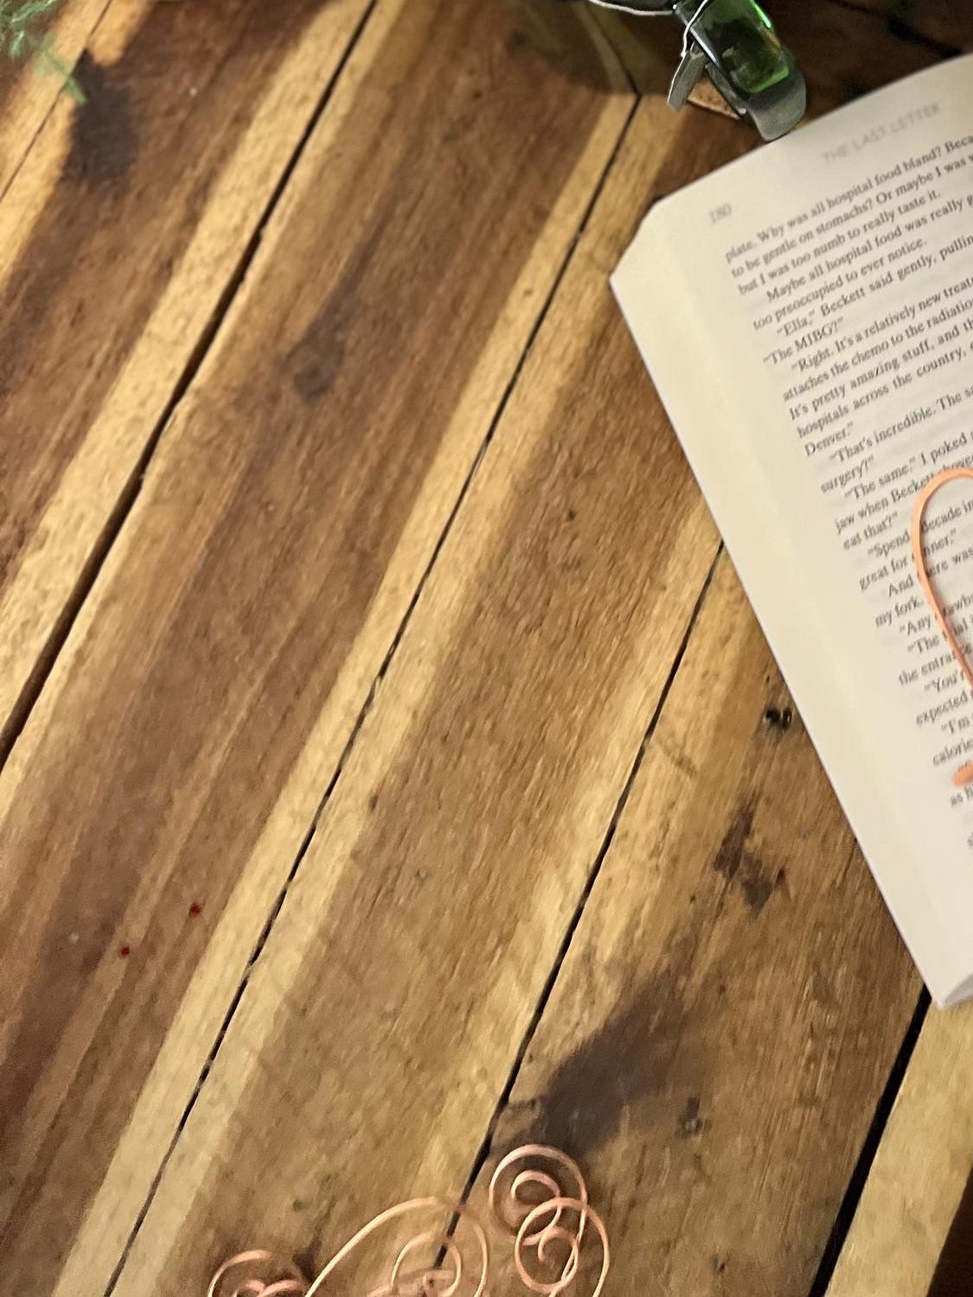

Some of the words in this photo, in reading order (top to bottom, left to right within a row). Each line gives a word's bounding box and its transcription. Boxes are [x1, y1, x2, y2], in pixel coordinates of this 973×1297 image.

[756, 224, 785, 243] Why
[786, 212, 809, 229] was
[810, 200, 826, 218] all
[825, 177, 874, 210] hospital
[874, 163, 903, 187] food
[819, 286, 867, 318] Beckett
[868, 270, 894, 293] said
[936, 323, 961, 346] and
[935, 392, 963, 411] The
